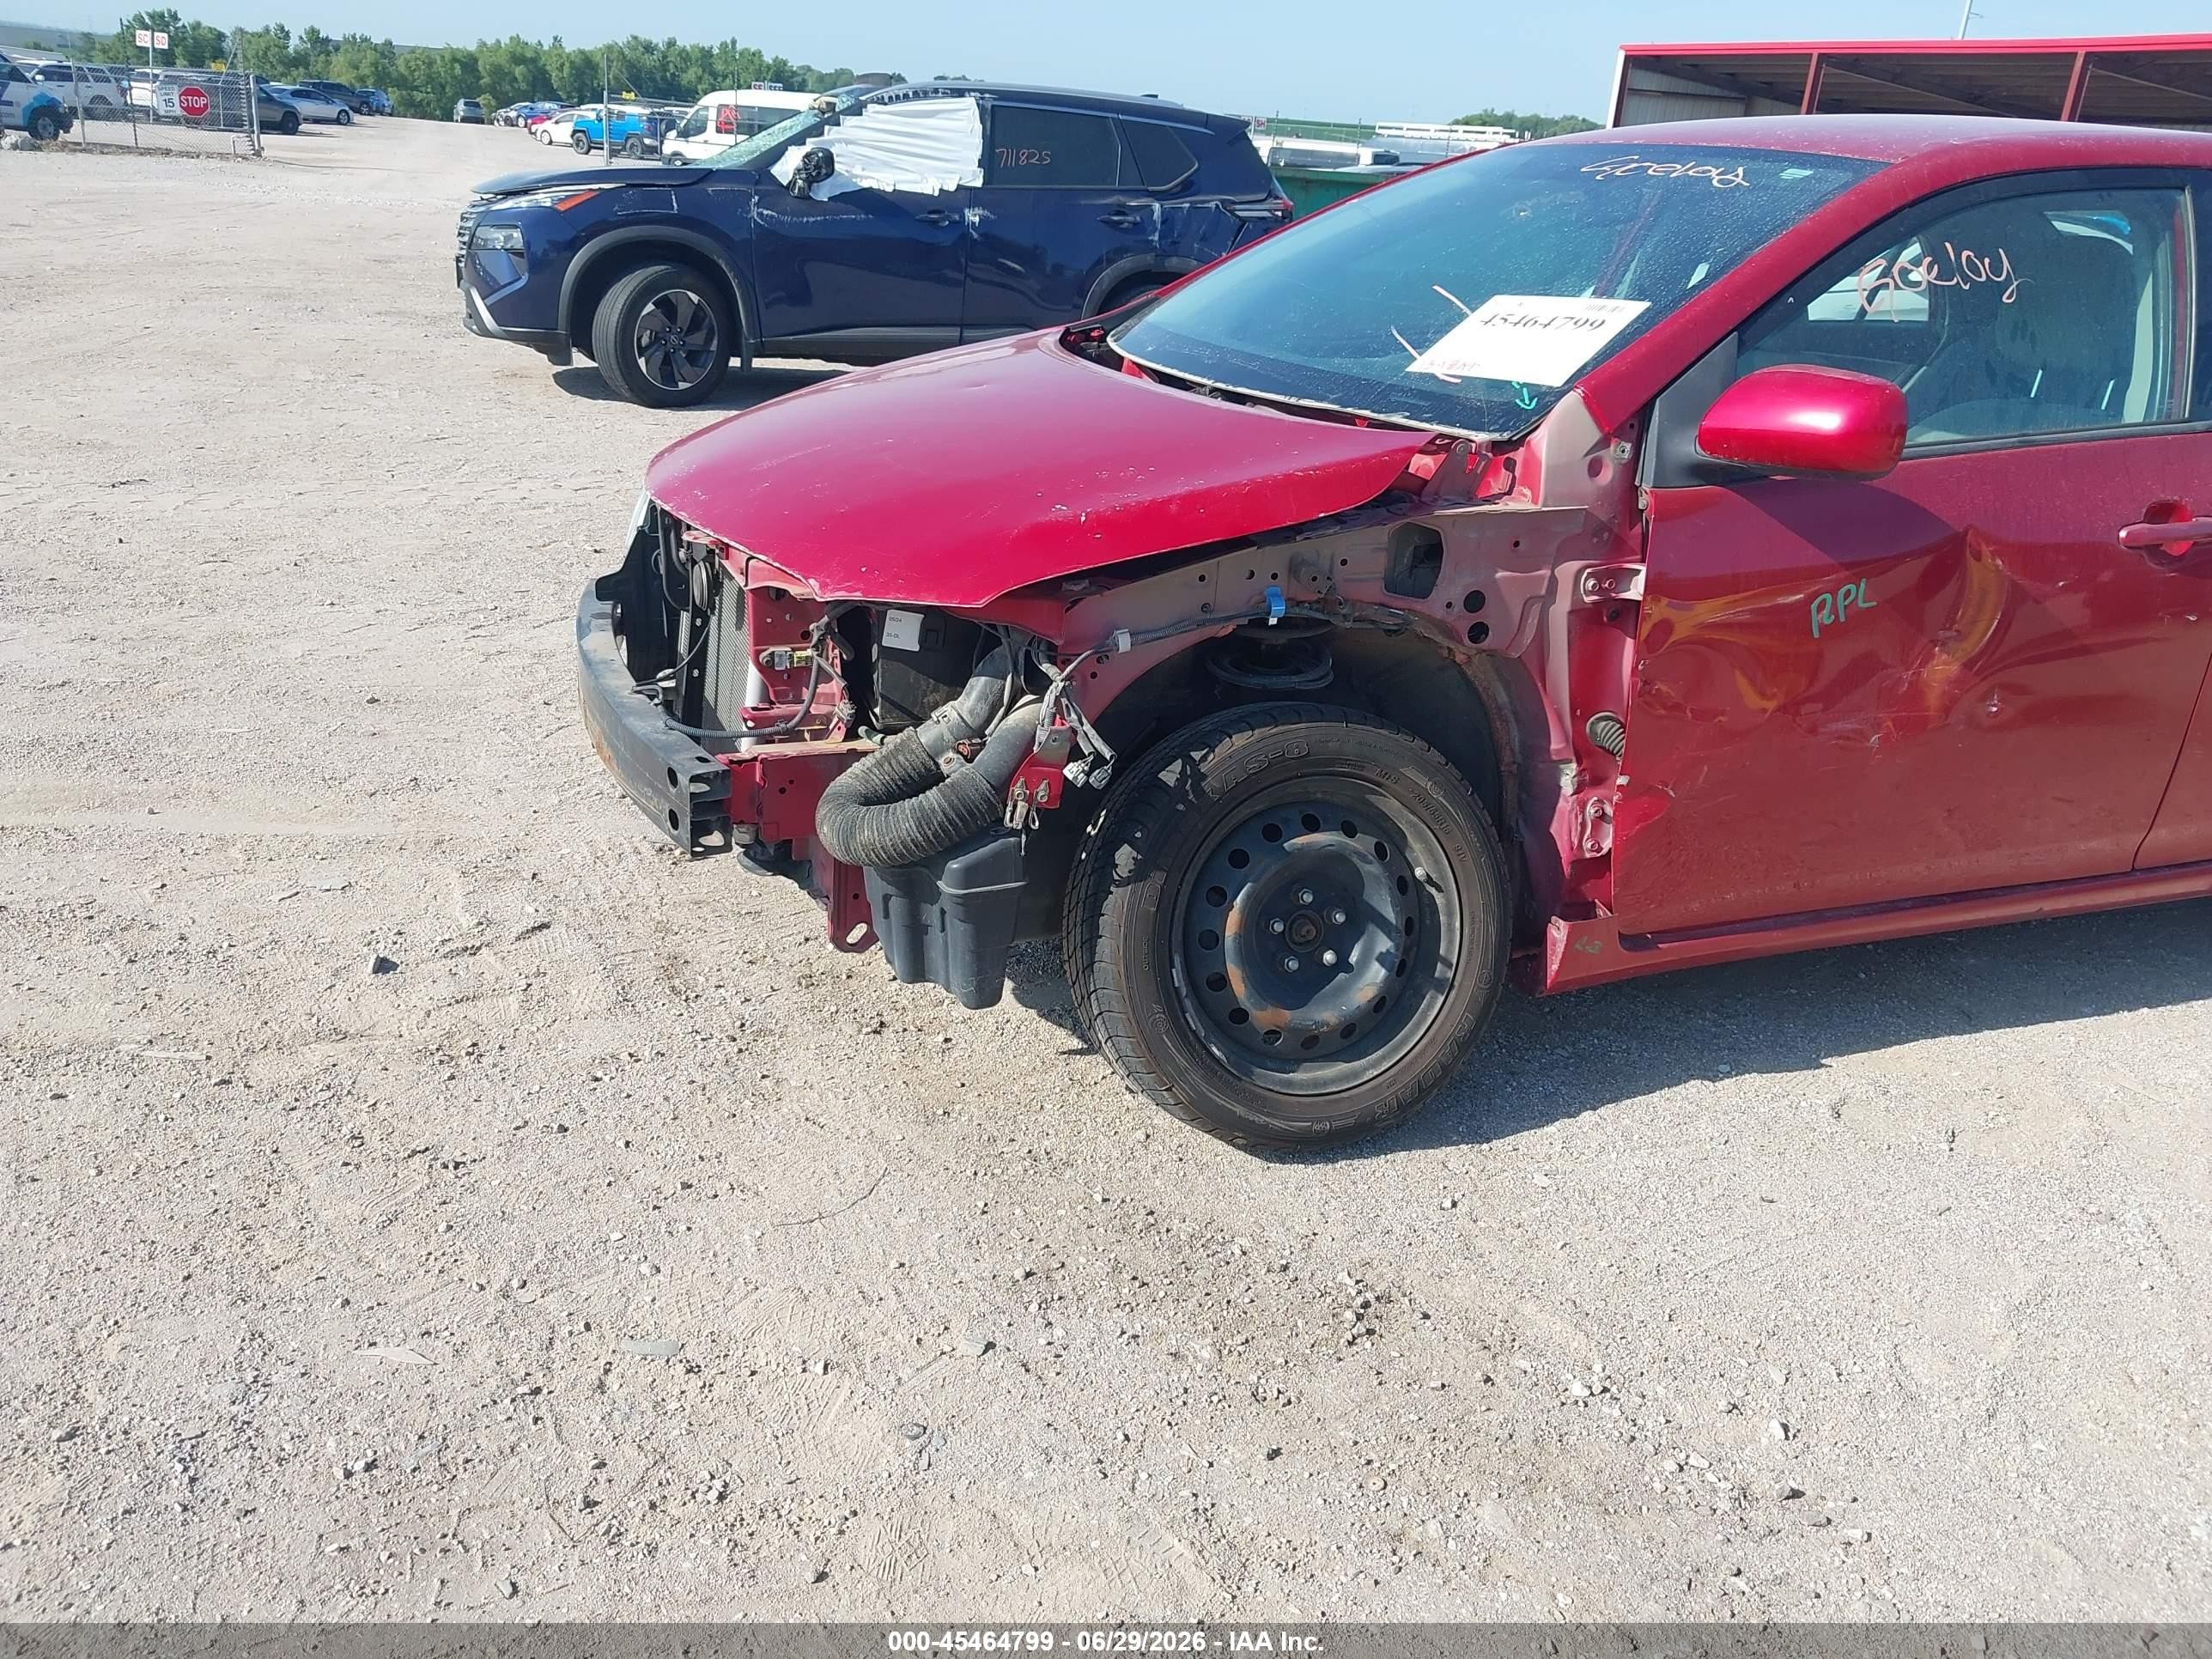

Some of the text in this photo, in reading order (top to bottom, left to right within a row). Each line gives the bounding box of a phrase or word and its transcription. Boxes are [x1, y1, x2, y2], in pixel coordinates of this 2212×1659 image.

[137, 33, 149, 44] SC
[155, 35, 167, 46] SD
[162, 98, 175, 108] 15
[180, 95, 207, 108] STOP
[995, 149, 1051, 168] 711825
[1480, 313, 1606, 331] 45464799
[1810, 578, 1877, 638] RPL
